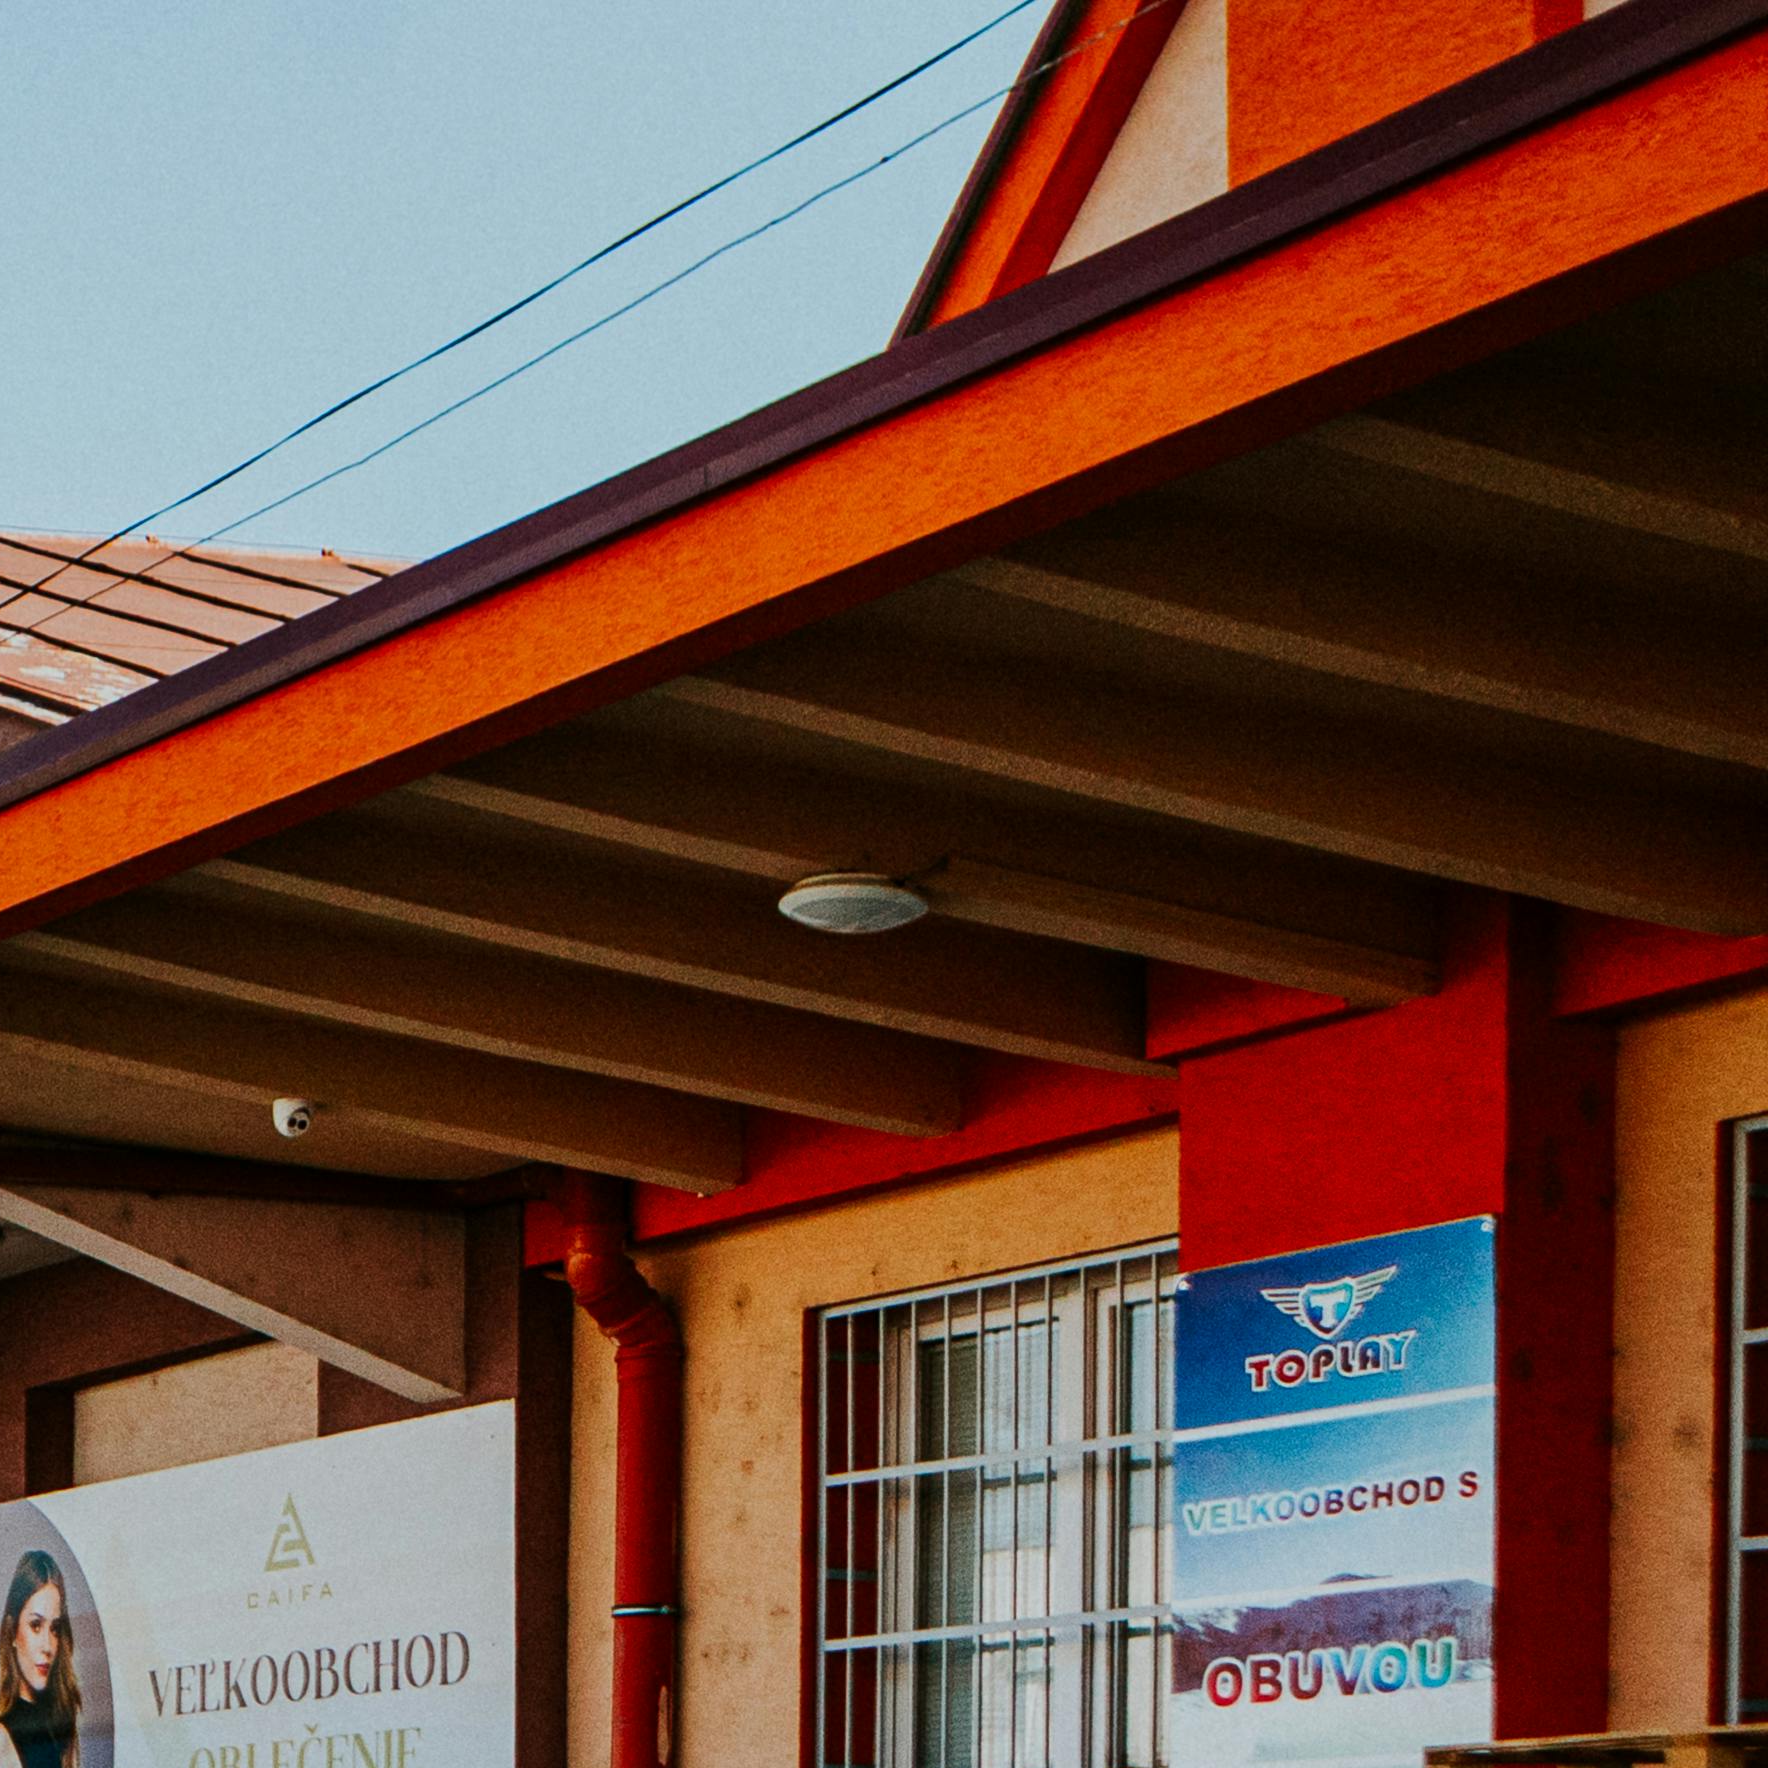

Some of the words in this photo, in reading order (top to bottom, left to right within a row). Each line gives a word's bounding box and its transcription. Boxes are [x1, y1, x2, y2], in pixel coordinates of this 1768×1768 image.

[1246, 1330, 1417, 1392] TOPLAY
[1185, 1477, 1445, 1534] VELKOOBCHOD
[1458, 1470, 1479, 1498] S
[246, 1582, 334, 1610] CAIFA
[148, 1630, 471, 1718] VEĽKOOBCHOD
[1206, 1638, 1455, 1707] OBUVOU
